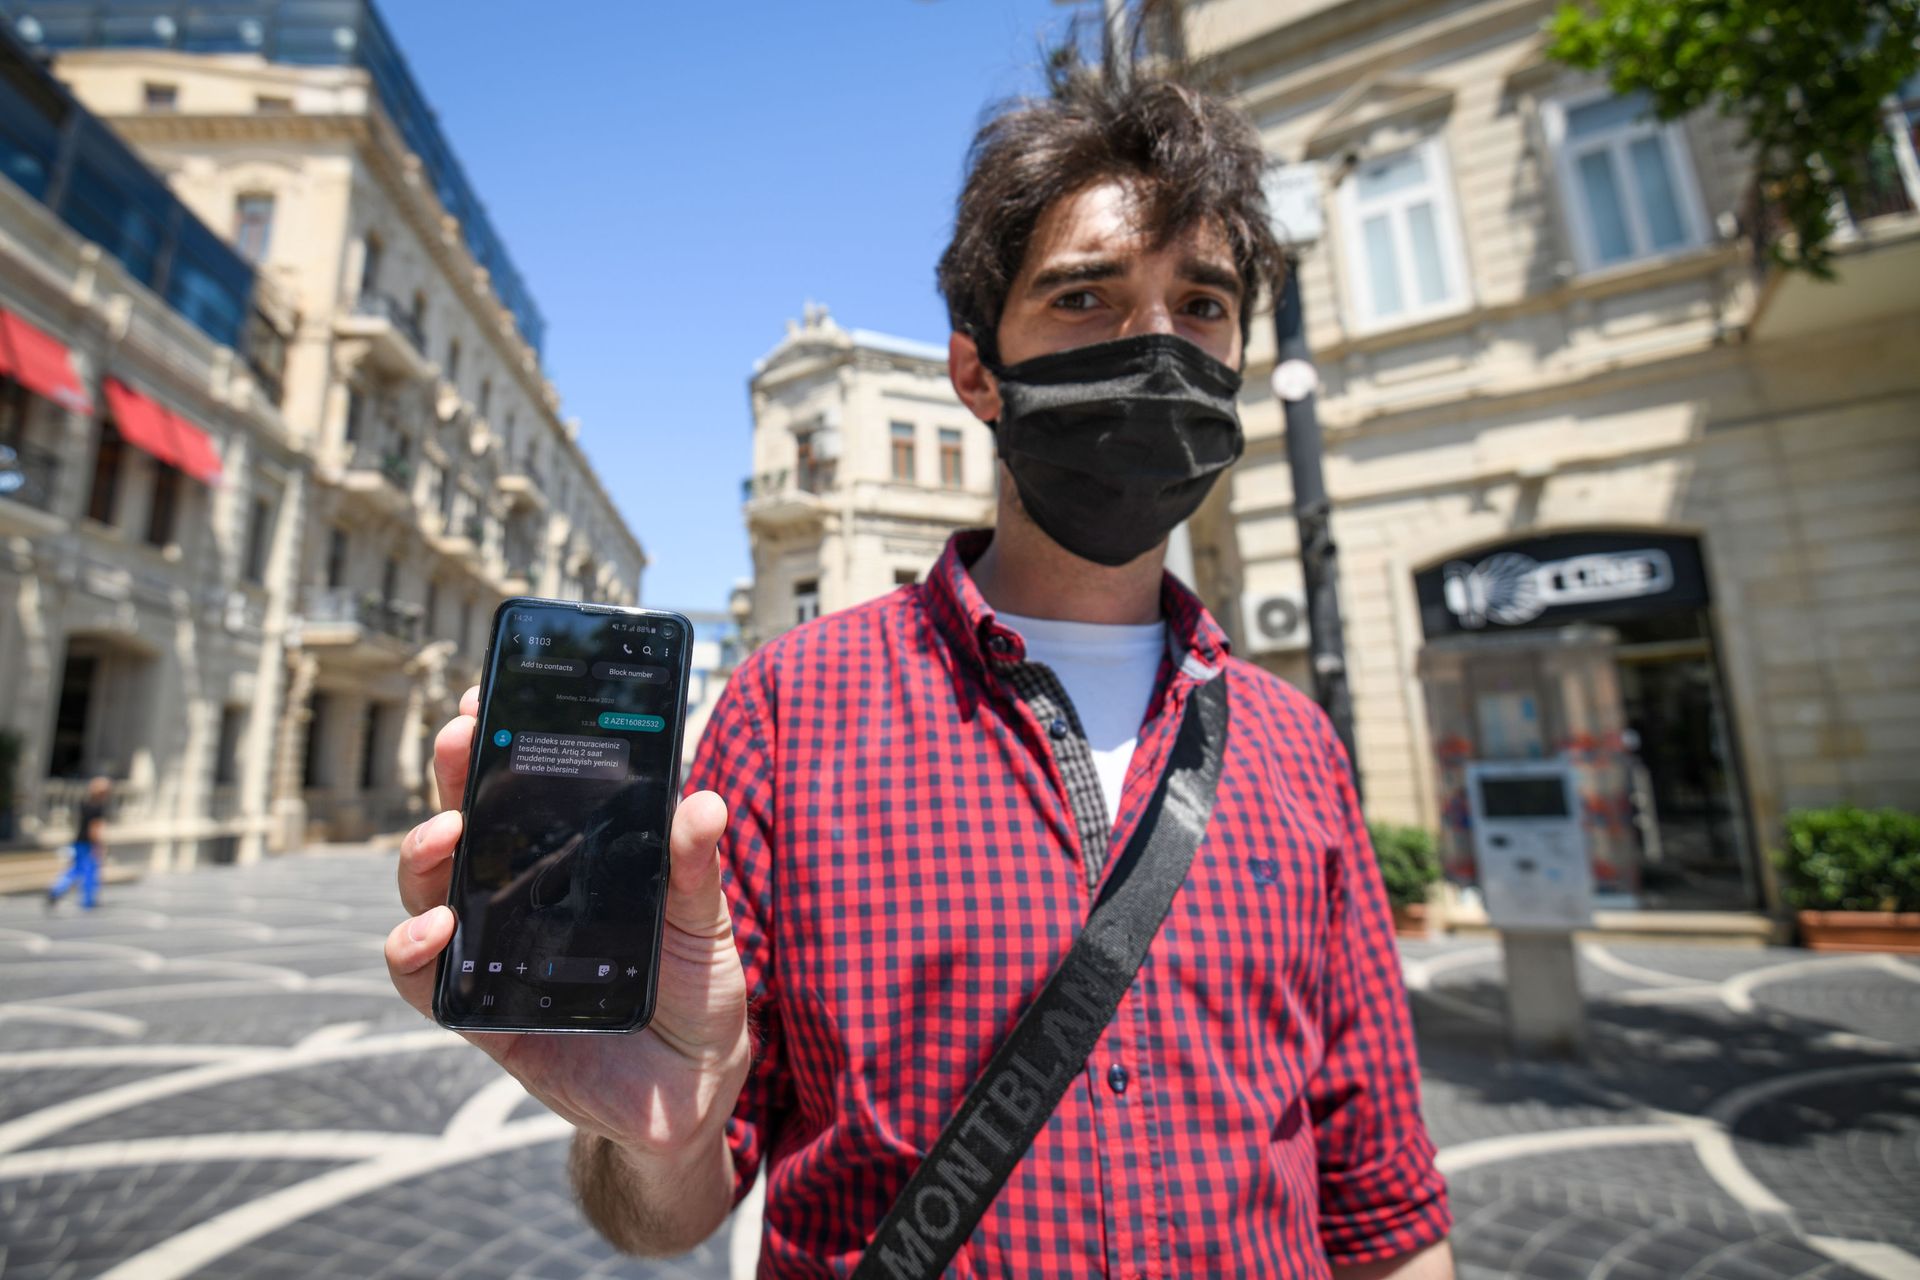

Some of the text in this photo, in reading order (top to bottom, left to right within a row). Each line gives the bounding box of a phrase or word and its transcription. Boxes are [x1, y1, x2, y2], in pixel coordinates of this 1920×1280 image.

[528, 636, 551, 646] 8103
[544, 664, 573, 672] contacts
[609, 668, 653, 679] Block number
[610, 717, 659, 728] AZE16082532
[534, 736, 558, 745] indeks
[577, 740, 620, 750] muracietiniz
[518, 745, 559, 754] tesdiqlendi.
[561, 748, 579, 756] Artiq
[517, 754, 619, 768] muddetine yashayish yerinizi
[515, 763, 530, 771] terk
[546, 765, 579, 774] bilersiniz
